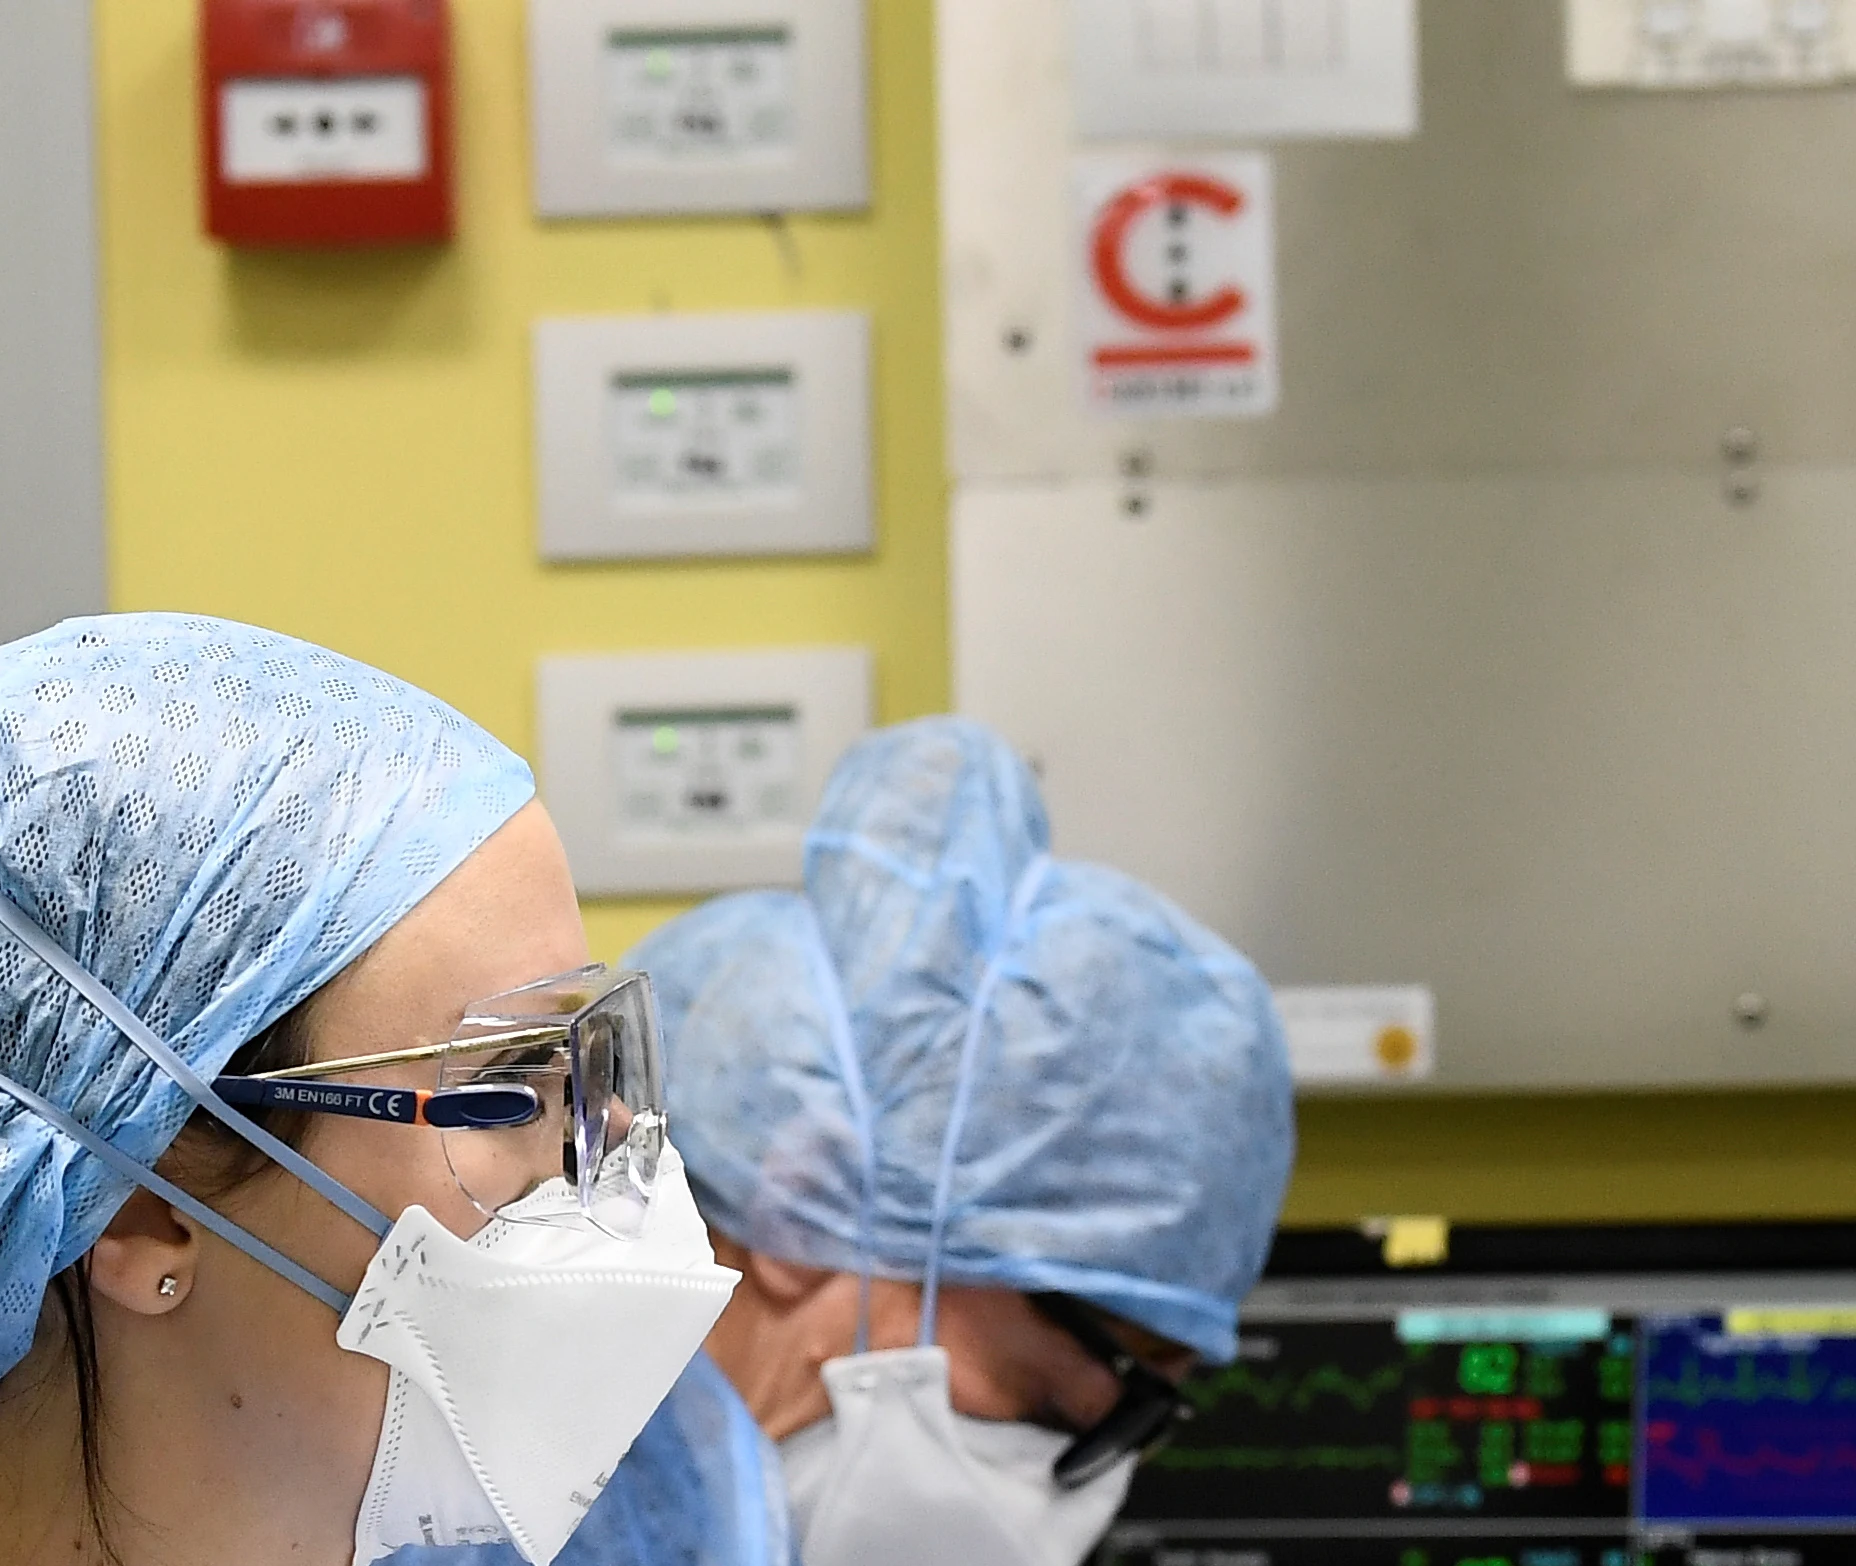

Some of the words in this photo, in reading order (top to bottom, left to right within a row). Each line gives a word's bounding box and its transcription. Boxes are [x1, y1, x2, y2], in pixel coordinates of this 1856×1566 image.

[274, 1087, 294, 1100] 3M
[345, 1094, 364, 1108] FT
[368, 1091, 403, 1117] CE
